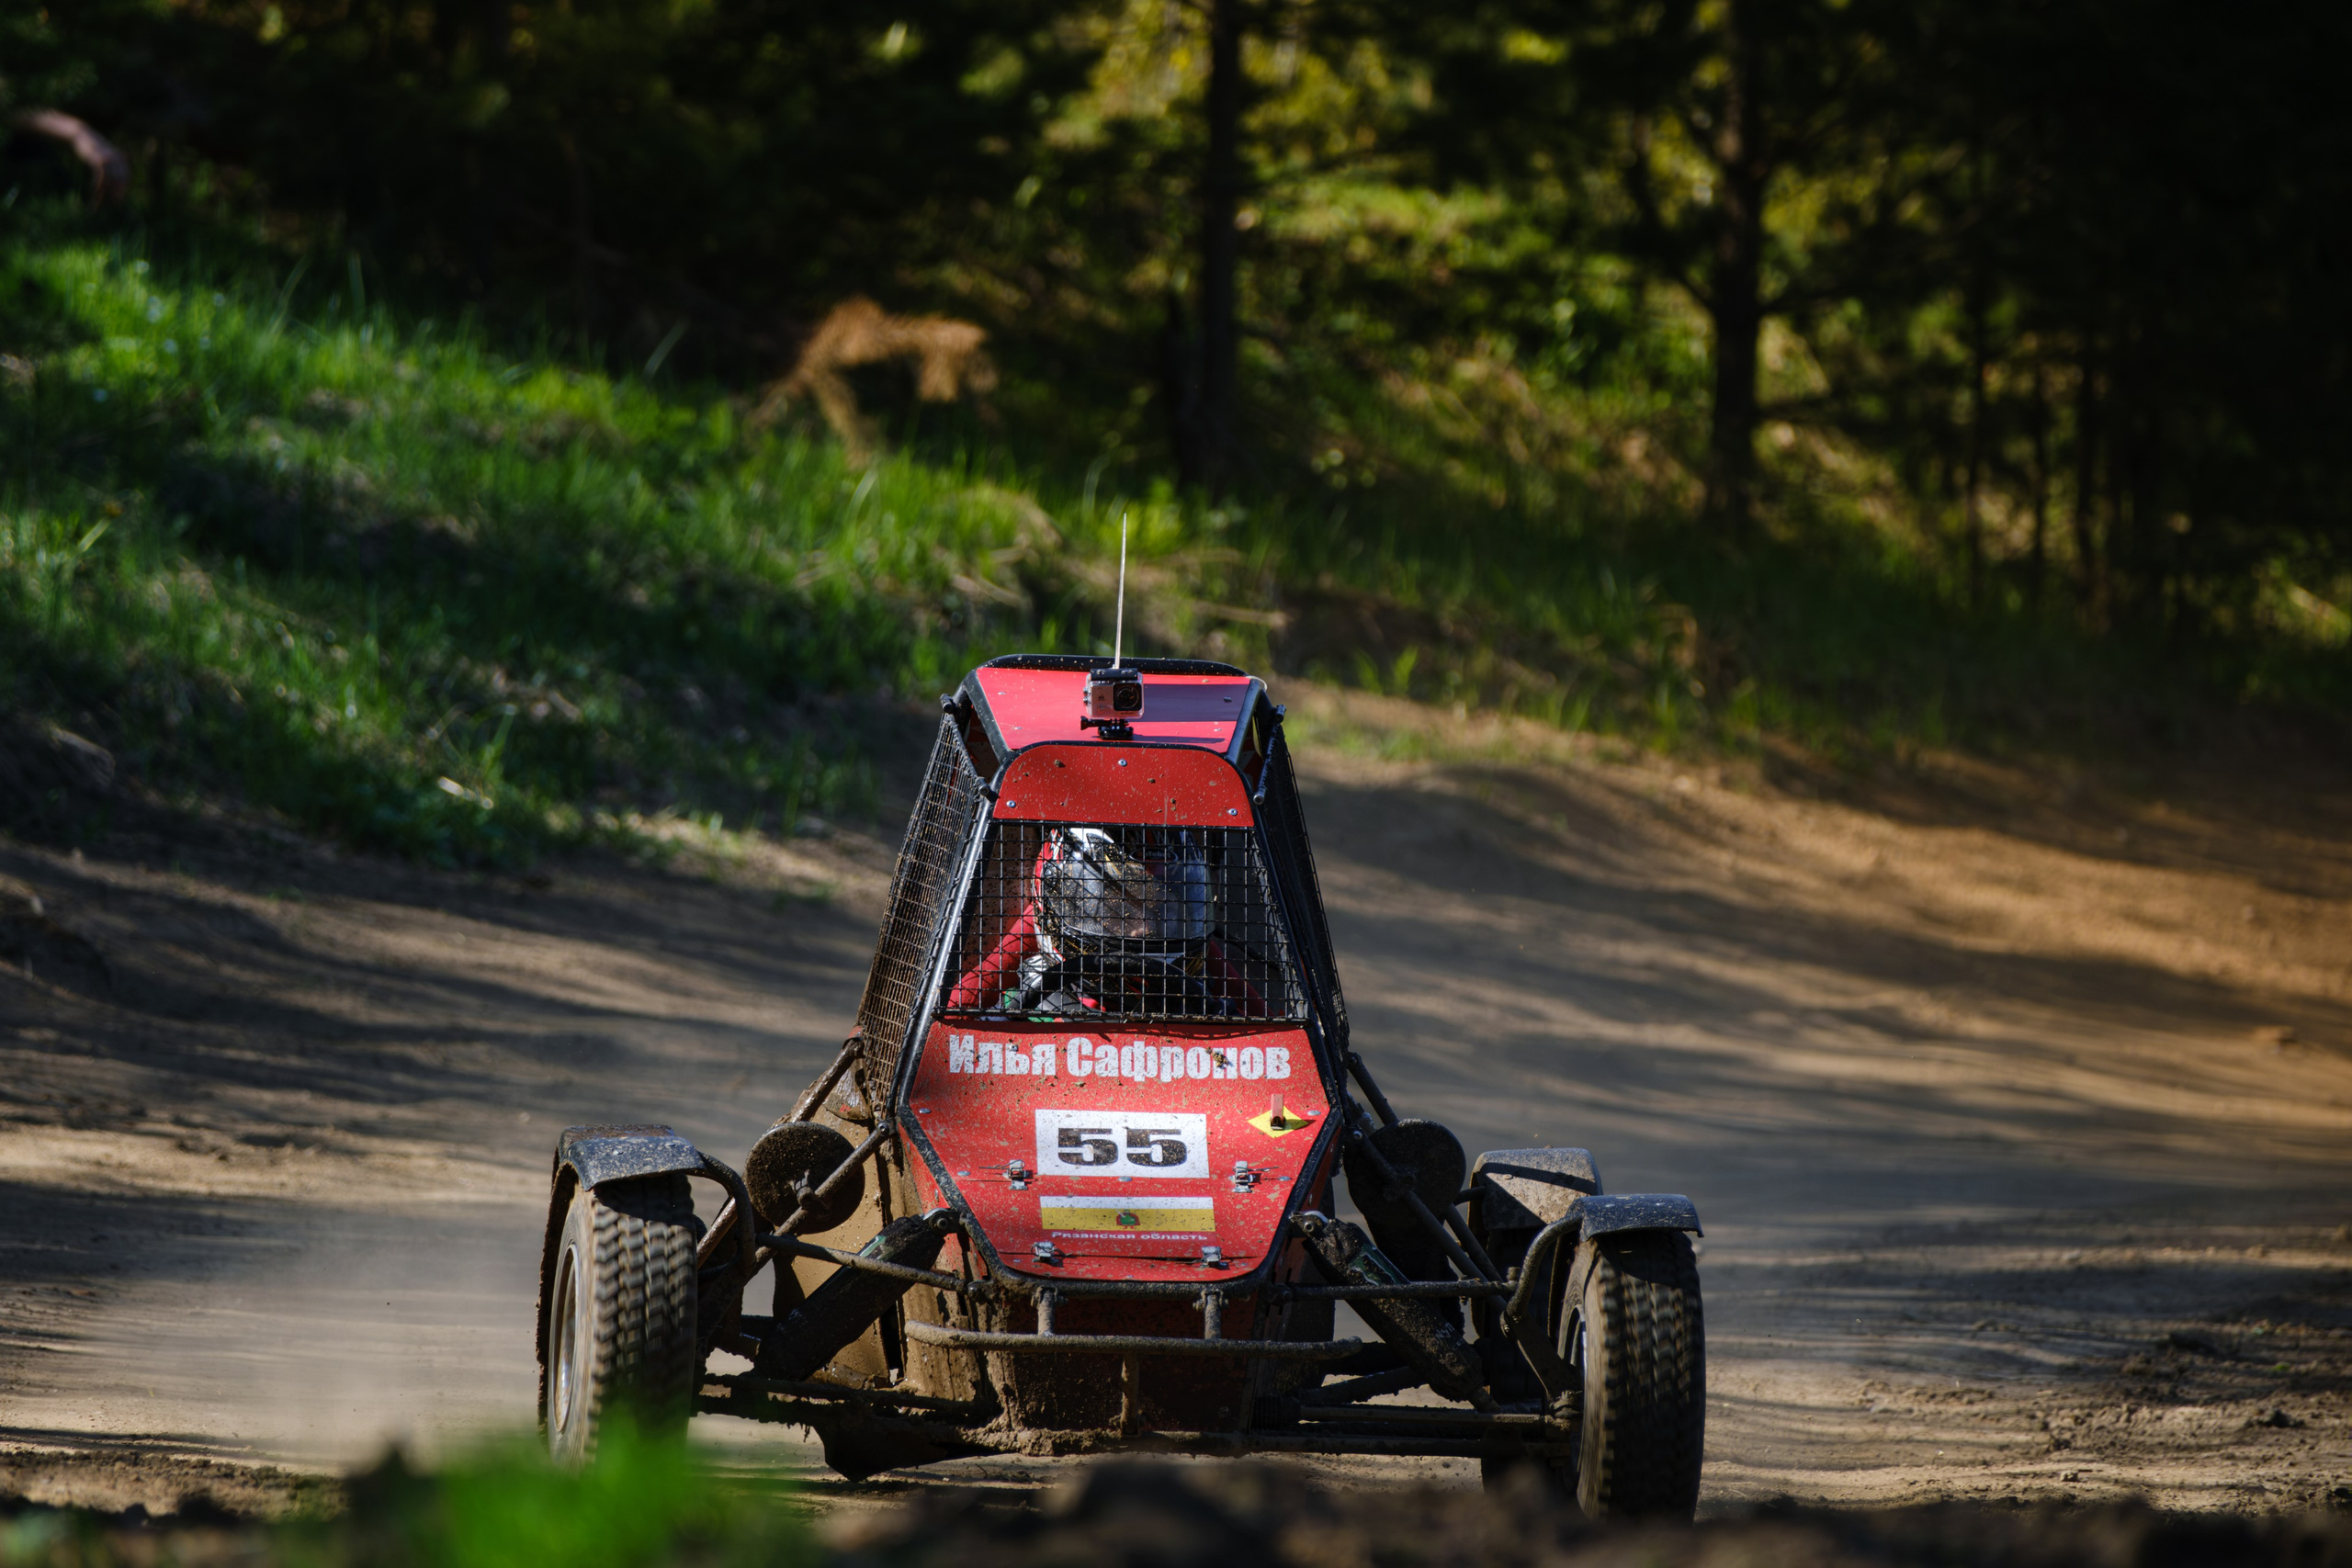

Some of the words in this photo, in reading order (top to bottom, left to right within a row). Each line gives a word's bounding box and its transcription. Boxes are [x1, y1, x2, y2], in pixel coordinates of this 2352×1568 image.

[949, 1034, 1057, 1076] Илья
[1067, 1036, 1291, 1083] Сафронов
[1057, 1127, 1188, 1168] 55
[1051, 1231, 1136, 1240] Рязанская
[1140, 1232, 1208, 1241] область
